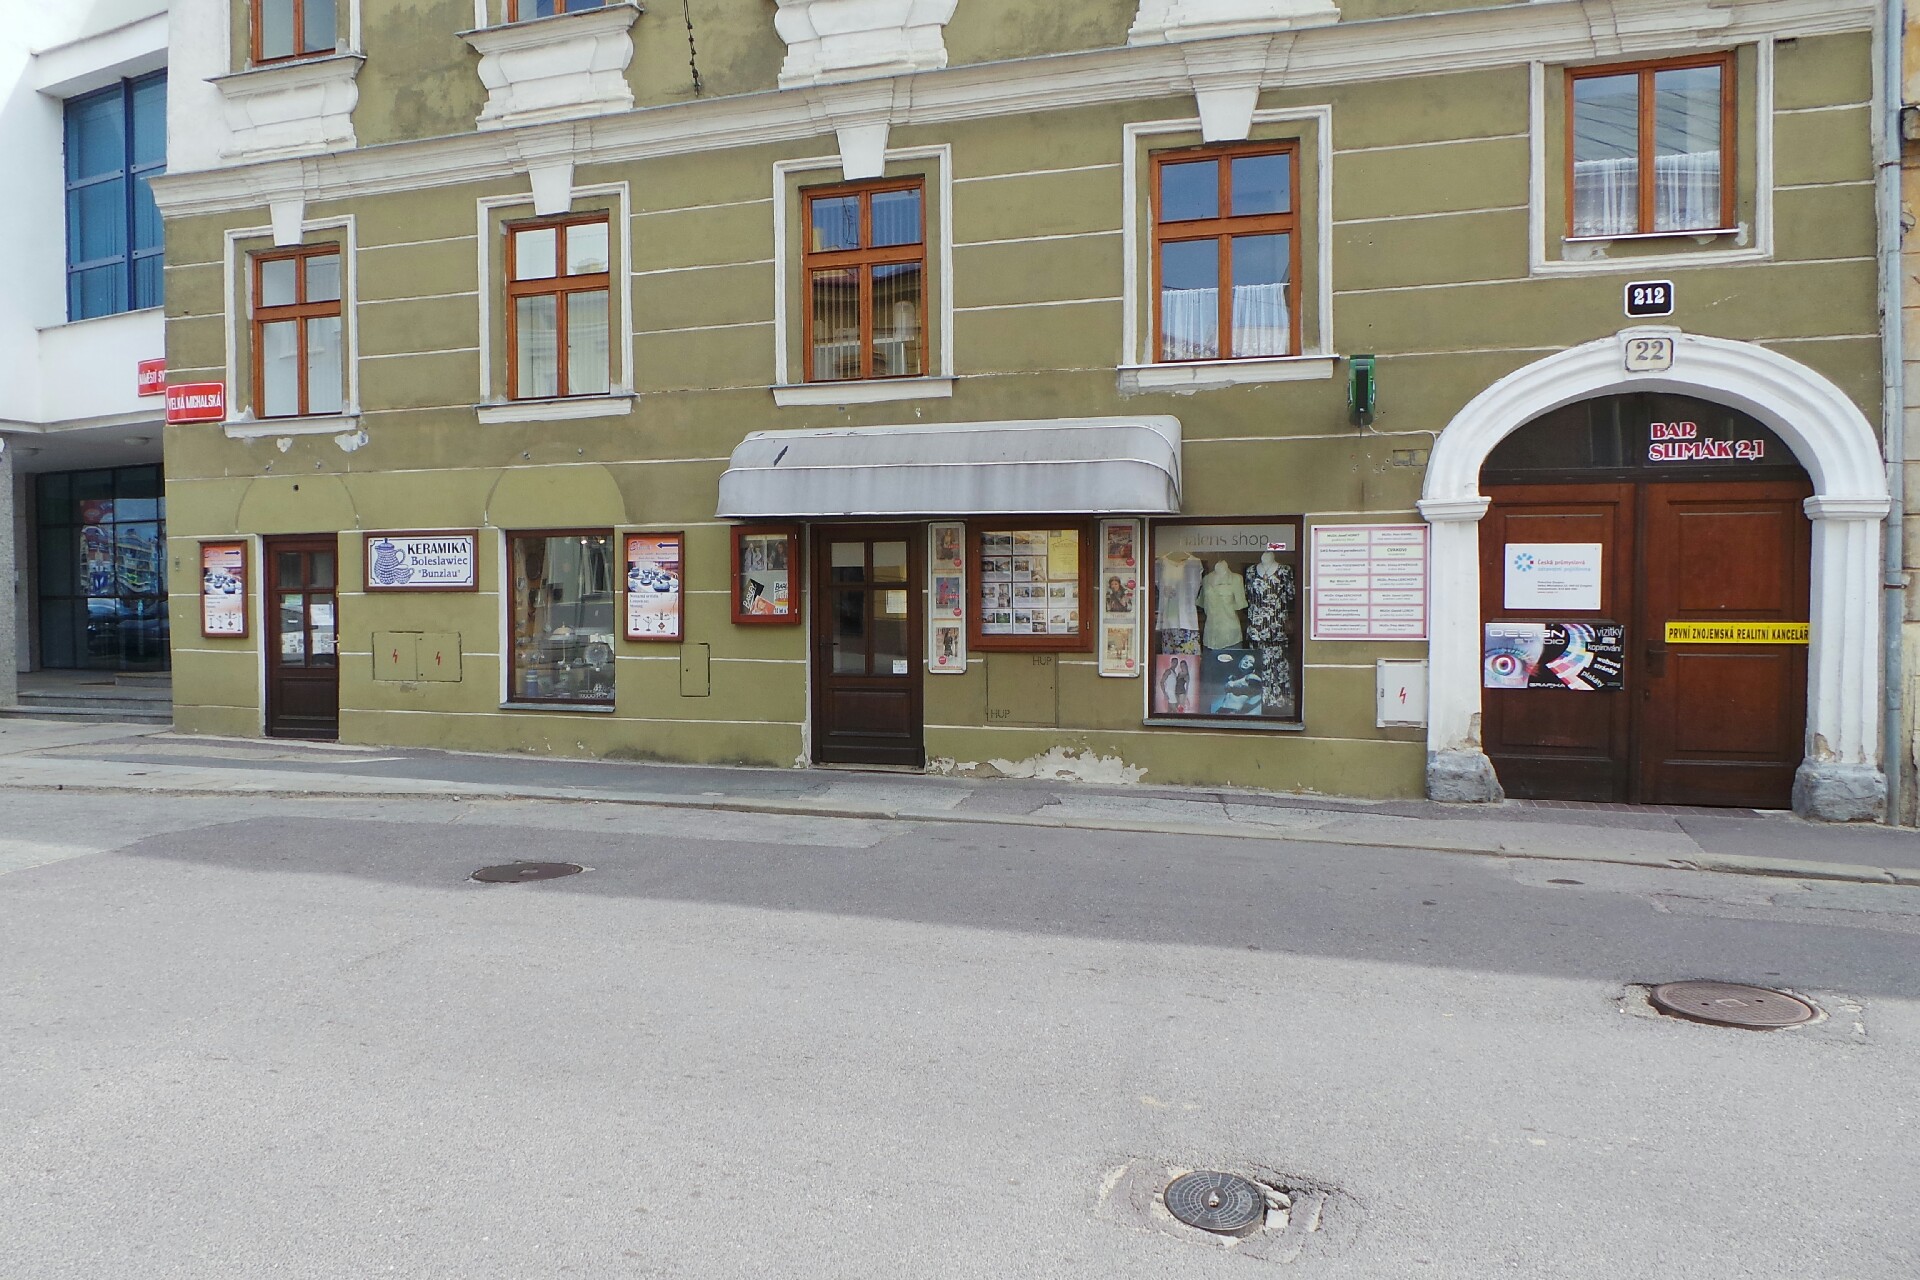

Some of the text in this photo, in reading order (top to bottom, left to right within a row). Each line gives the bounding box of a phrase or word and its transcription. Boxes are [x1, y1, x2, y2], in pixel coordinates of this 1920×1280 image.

[1634, 287, 1665, 305] 212
[1635, 340, 1664, 361] 22
[167, 391, 222, 410] VELKÁ MICHALSKÁ
[1650, 421, 1697, 440] BAR
[1648, 437, 1733, 461] SLIMÁK
[1231, 531, 1269, 548] shop
[407, 542, 467, 554] KERAMIKA
[411, 555, 468, 566] Boleslawiec
[1489, 629, 1565, 638] DESIGN
[1596, 626, 1623, 639] vizitky
[1669, 625, 1808, 640] PRVNÍ ZNOJEMSKÁ REALITNÍ KANCELÁŘ
[1587, 643, 1622, 652] kopírování
[1032, 655, 1052, 666] HUP
[1580, 670, 1605, 688] plakáty
[990, 709, 1010, 719] HUP
